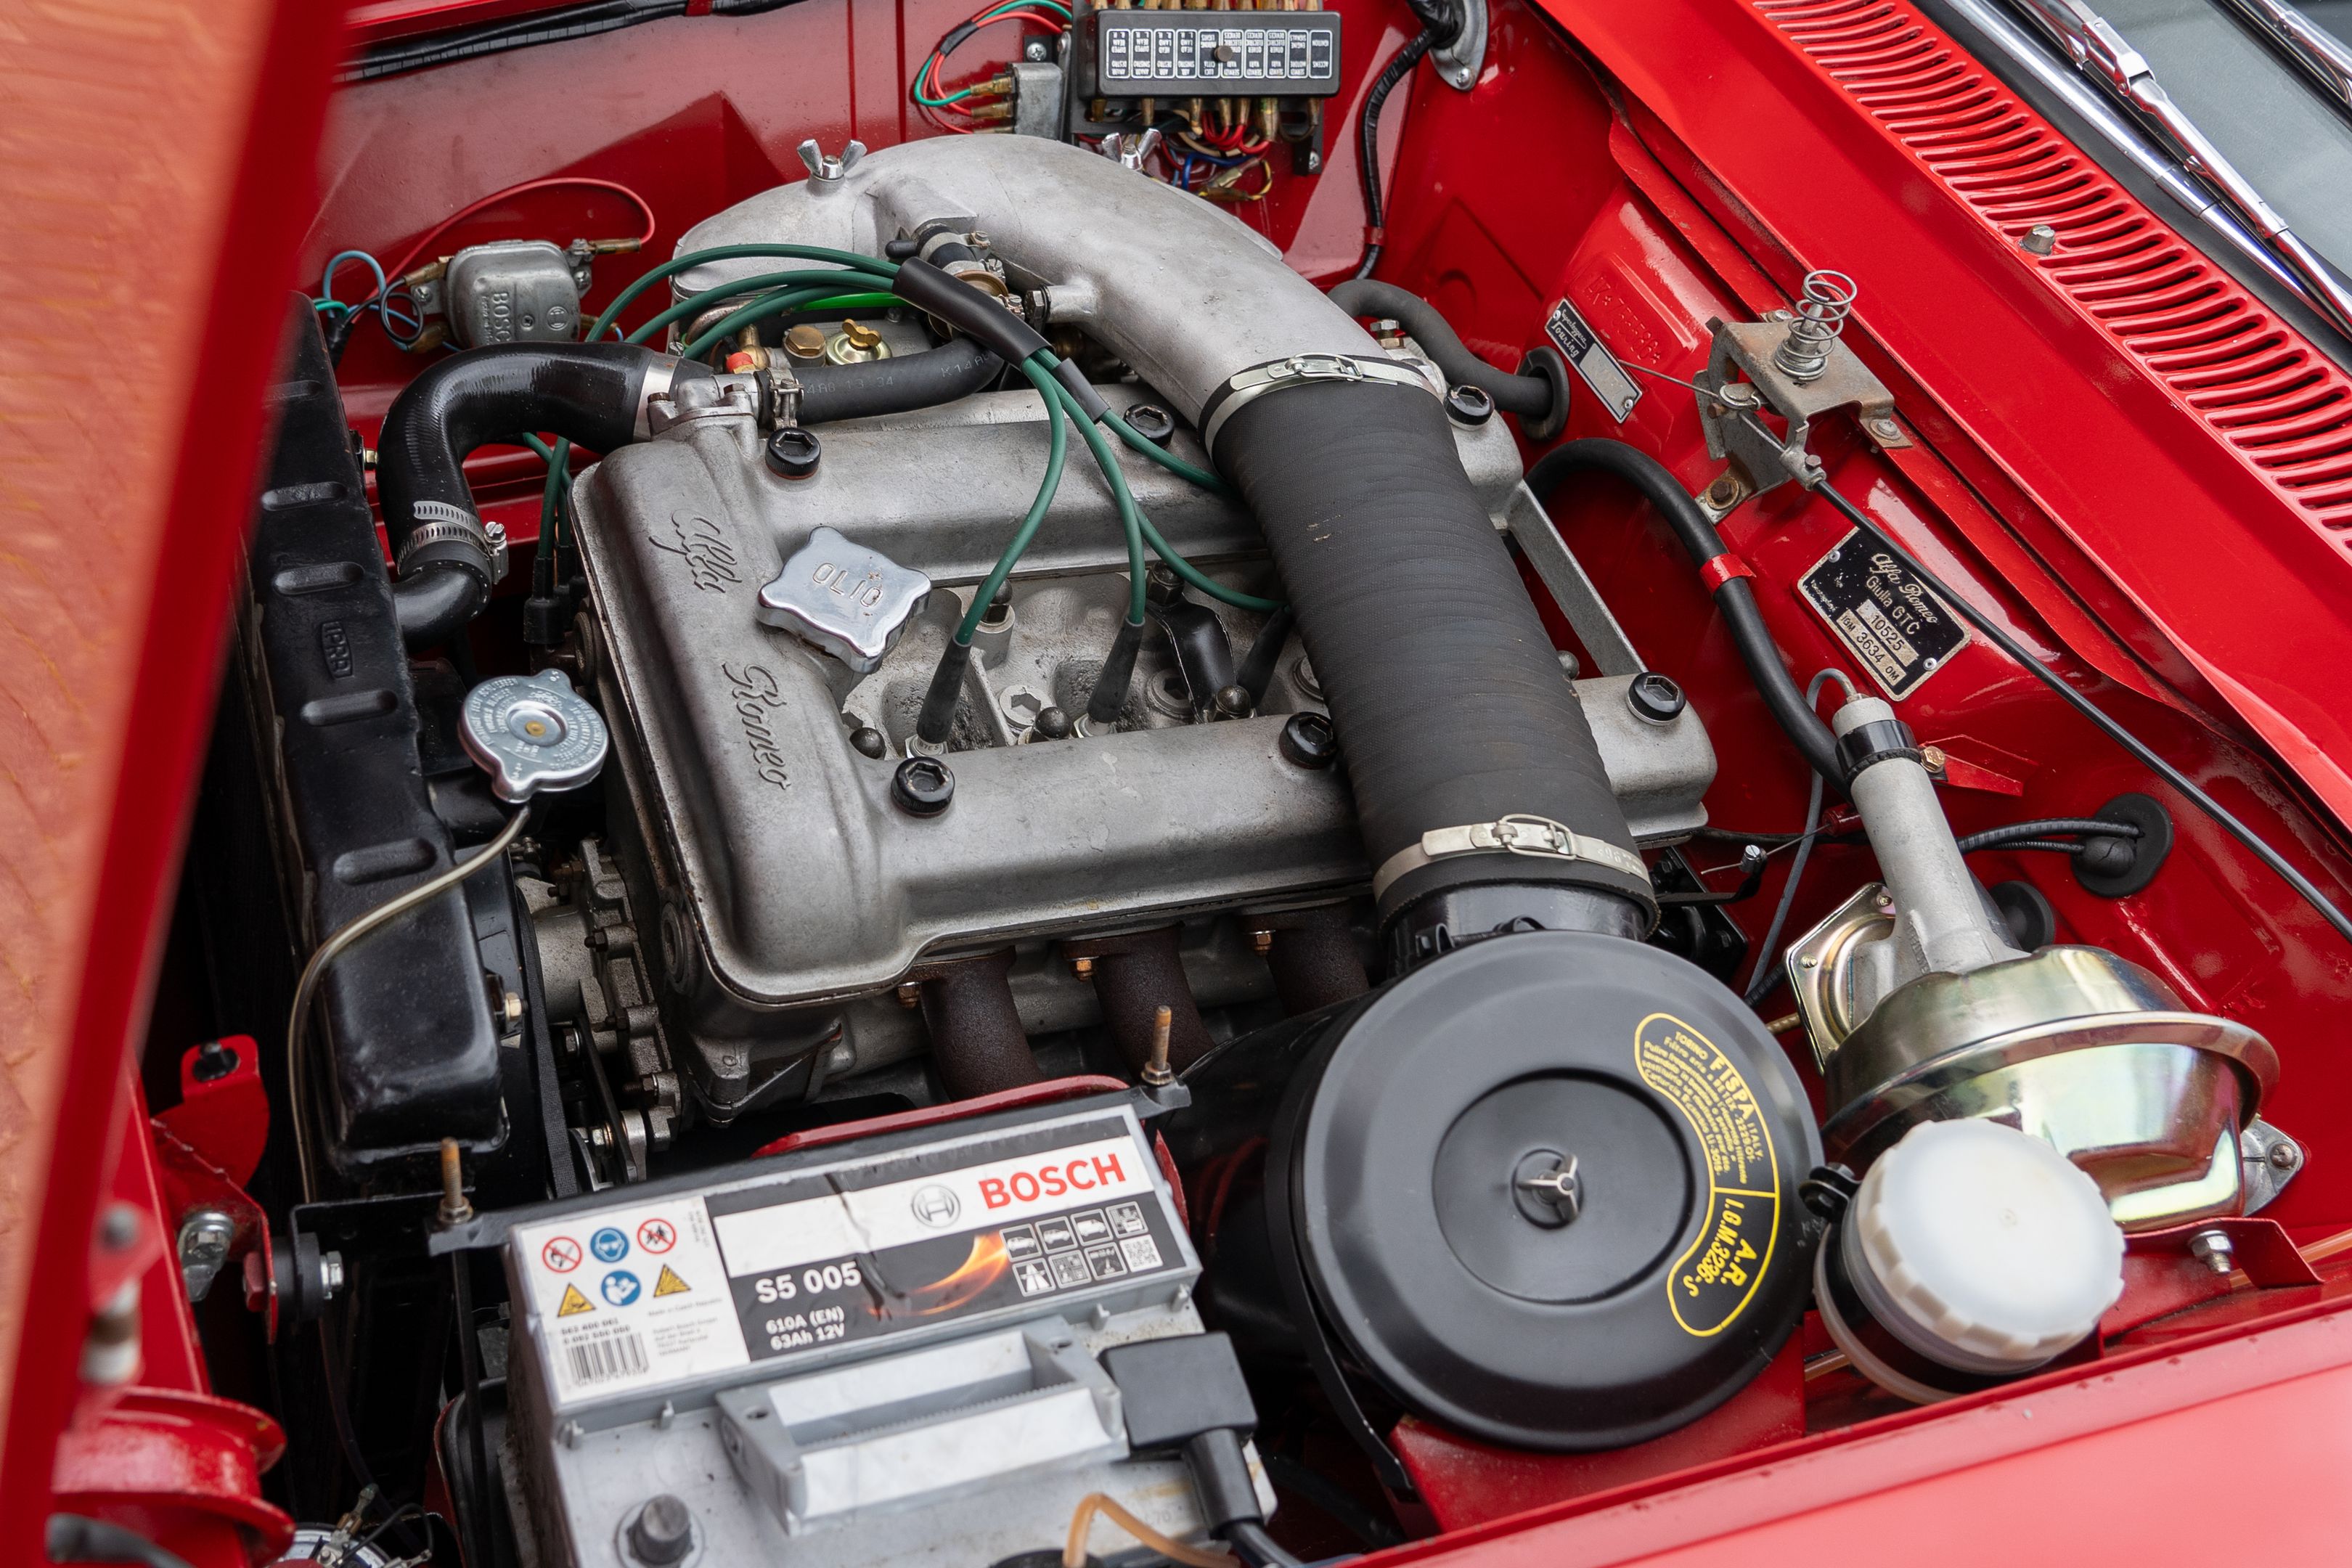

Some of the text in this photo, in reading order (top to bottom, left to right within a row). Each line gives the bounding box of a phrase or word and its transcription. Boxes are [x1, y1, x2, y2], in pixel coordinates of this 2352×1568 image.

[491, 292, 510, 342] BOSC
[1551, 321, 1580, 358] Touring
[812, 562, 884, 608] OLIO
[1866, 576, 1921, 635] Giulia GTC
[1869, 553, 1938, 624] Alfa Romeo
[648, 509, 791, 790] Alfa Romeo
[1856, 632, 1886, 663] 3634
[1885, 666, 1900, 681] OM
[1871, 614, 1905, 651] 10525
[1643, 1040, 1669, 1058] Pulire
[1675, 1031, 1709, 1061] TORINO
[1709, 1055, 1755, 1120] FISPA
[978, 1153, 1126, 1209] BOSCH
[755, 1260, 862, 1304] S5 005
[1720, 1238, 1757, 1286] A.R.
[765, 1305, 845, 1335] 610A (EN)
[770, 1323, 845, 1351] 63Ah 12V
